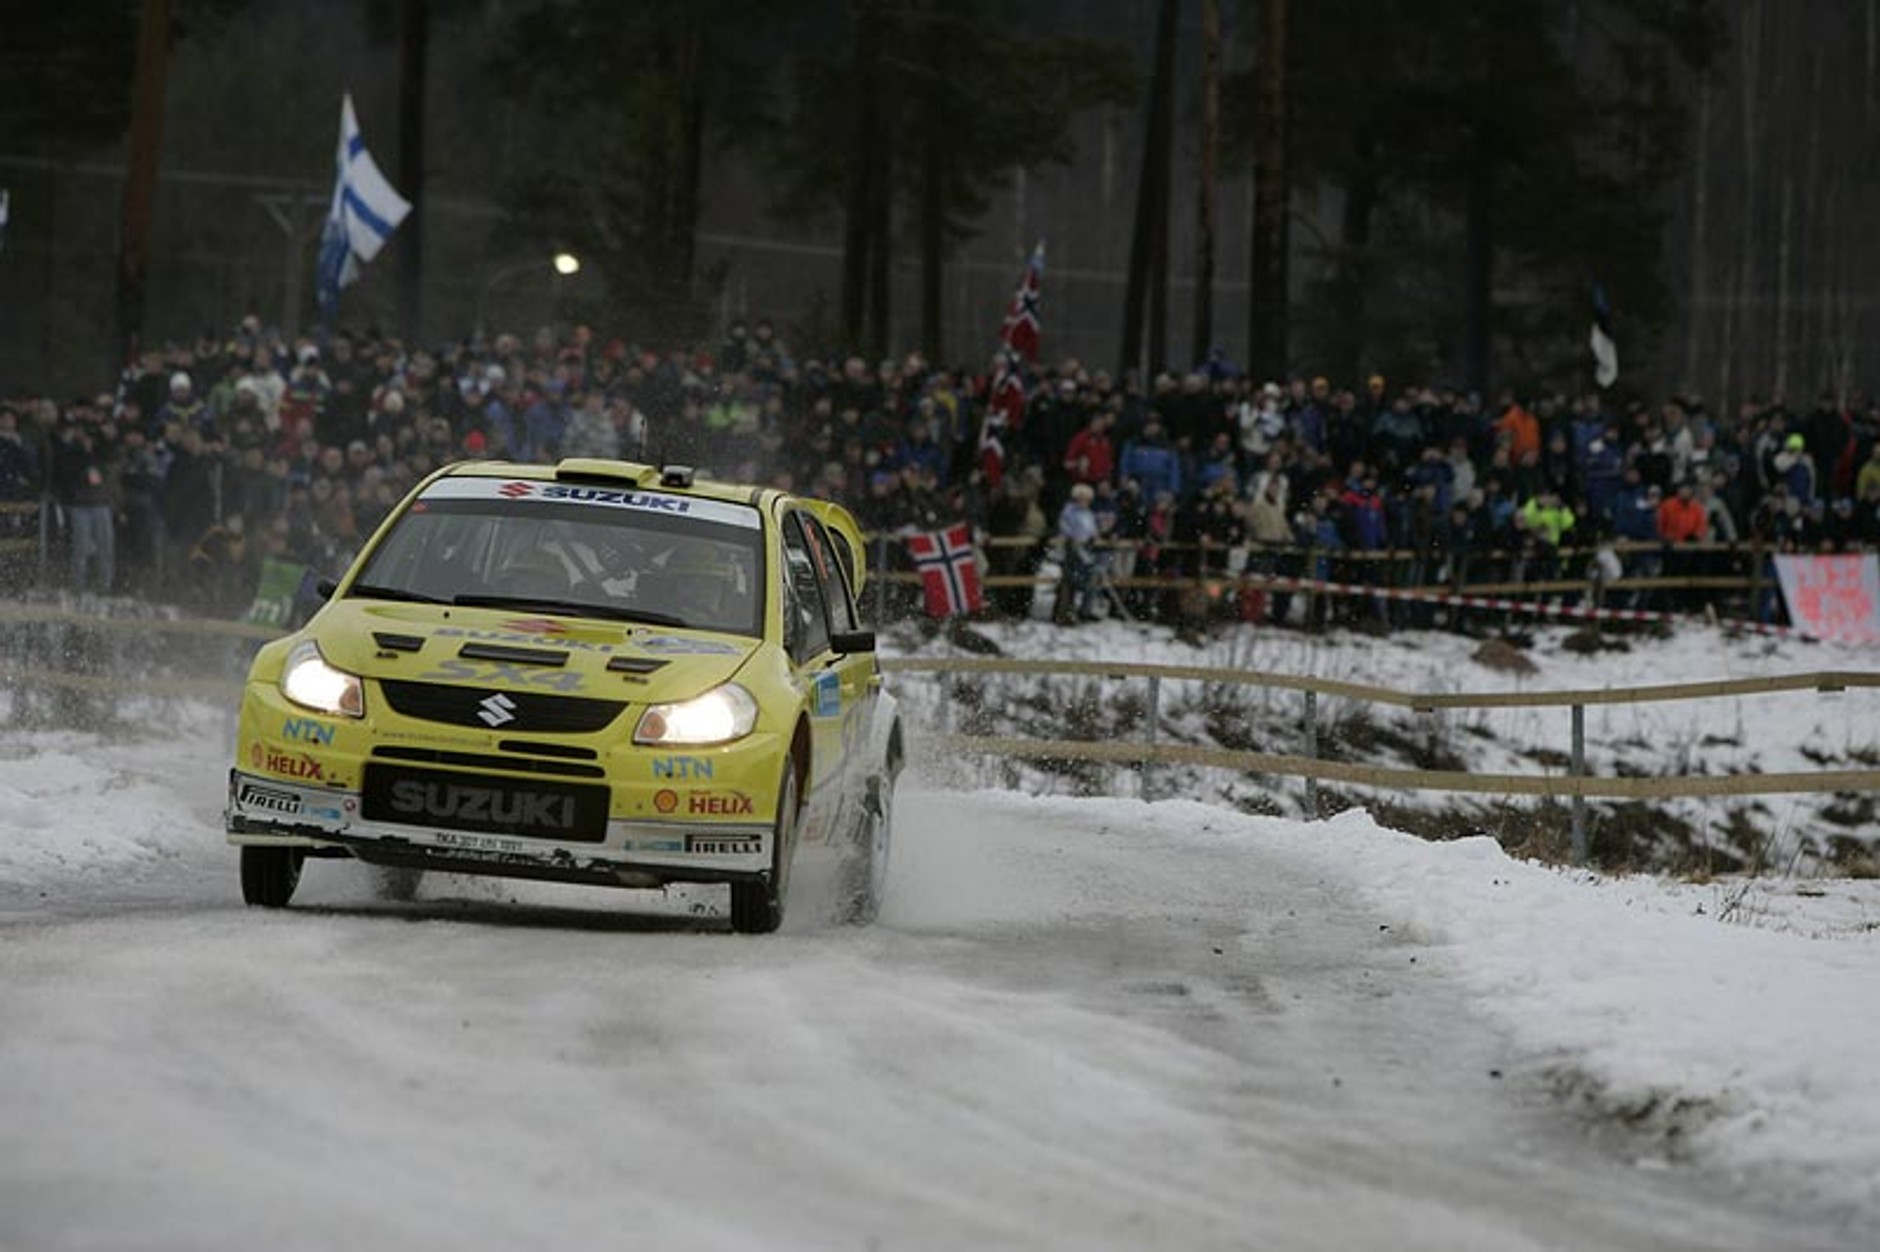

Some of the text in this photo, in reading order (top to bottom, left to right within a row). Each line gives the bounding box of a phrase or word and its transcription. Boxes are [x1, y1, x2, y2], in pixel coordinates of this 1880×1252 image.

[541, 484, 691, 513] SUZUKI
[434, 629, 613, 651] SUZUKI
[421, 660, 584, 691] SX4
[282, 719, 335, 745] NTN
[267, 753, 323, 780] HELIX
[653, 755, 713, 779] NTN
[240, 784, 301, 814] PIRELLI
[391, 781, 575, 829] SUZUKI
[689, 793, 753, 814] HELIX
[685, 834, 763, 854] PIRELLI
